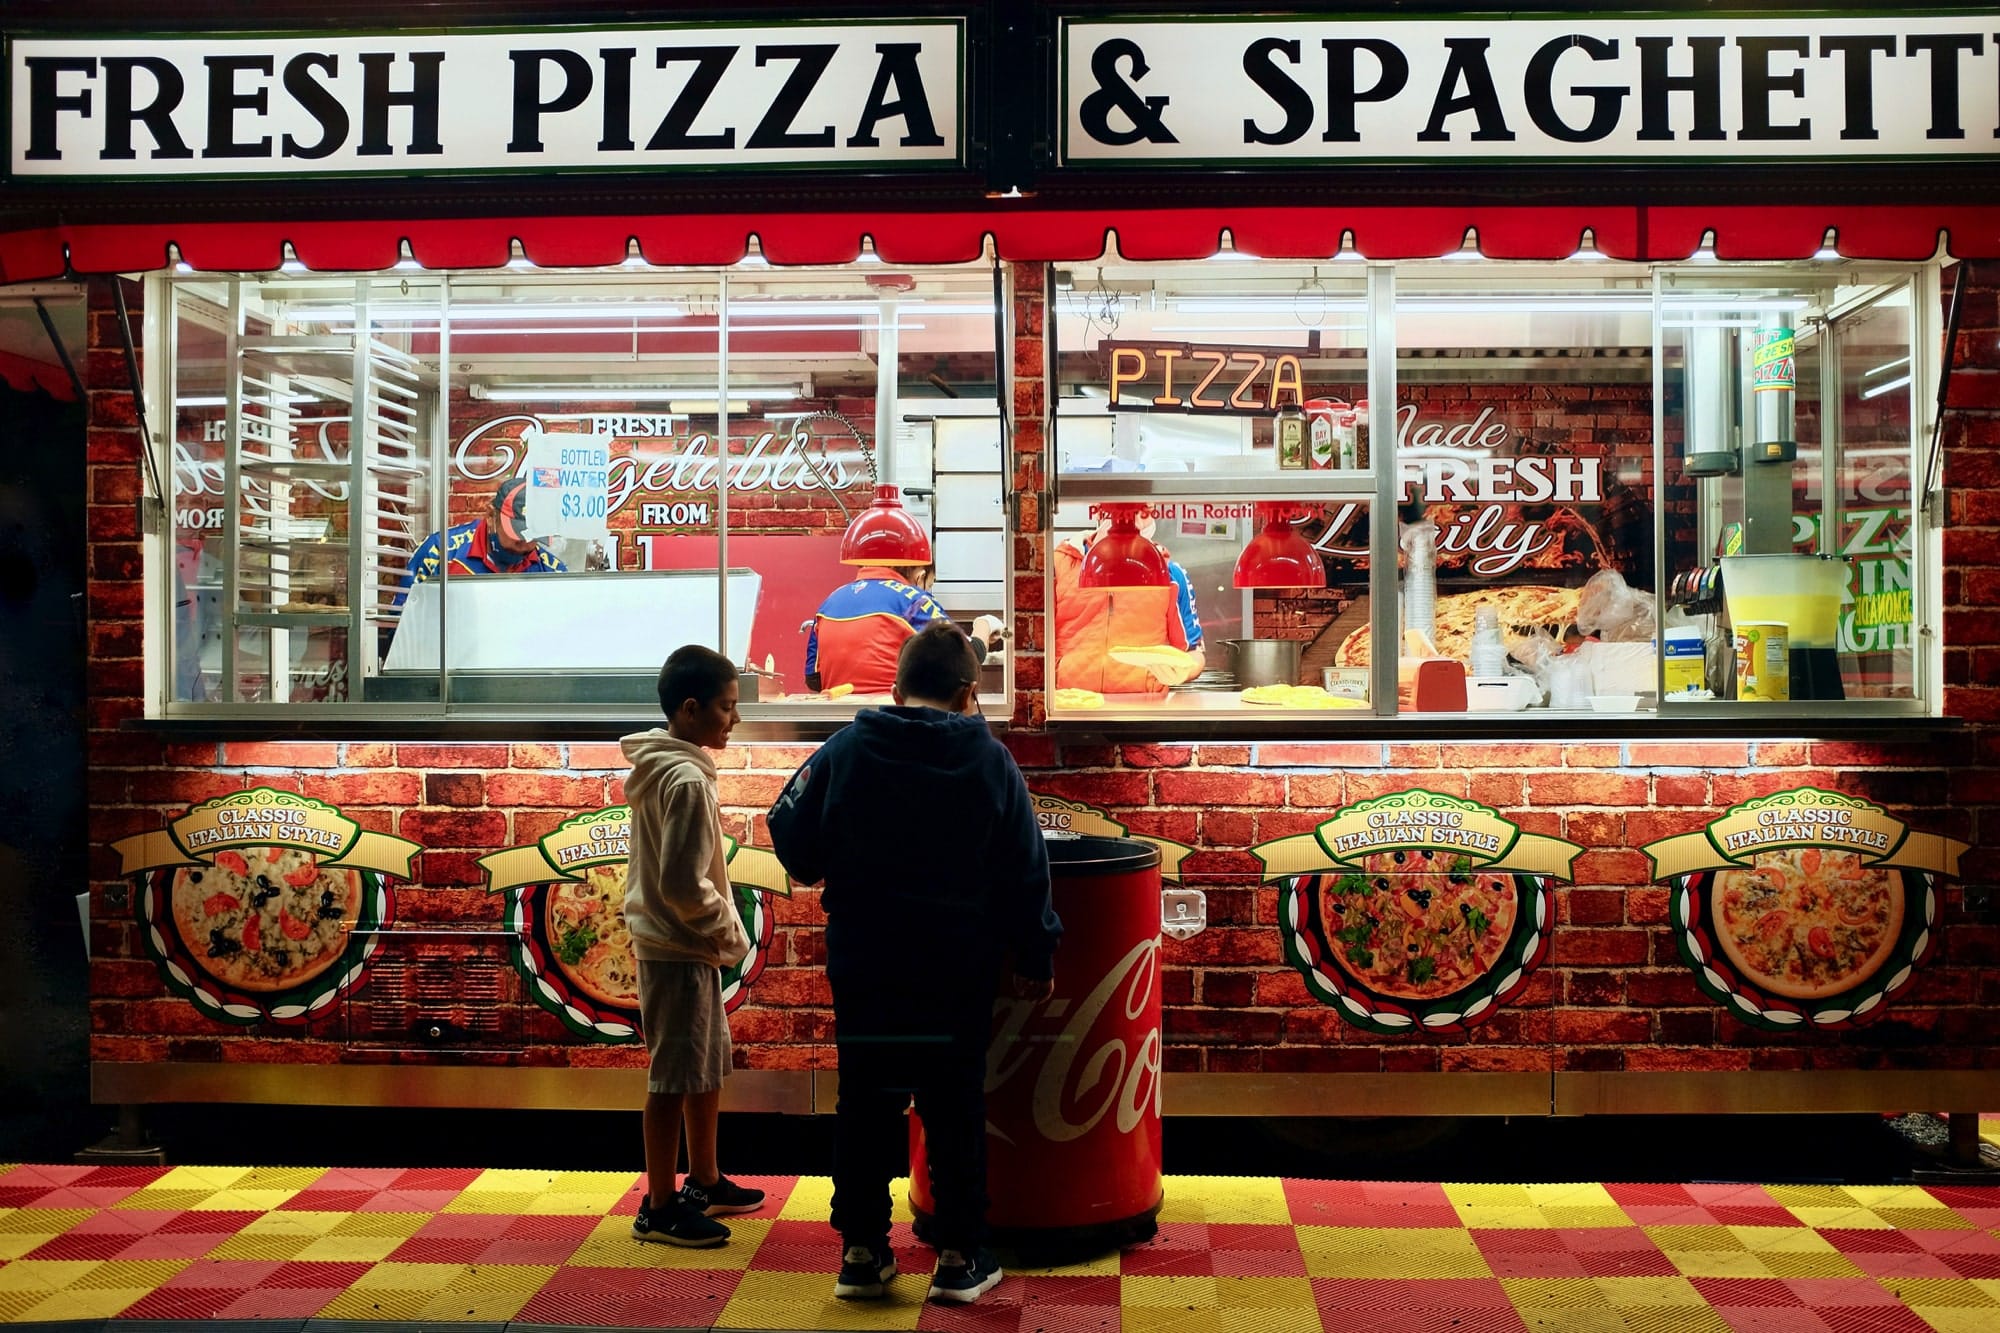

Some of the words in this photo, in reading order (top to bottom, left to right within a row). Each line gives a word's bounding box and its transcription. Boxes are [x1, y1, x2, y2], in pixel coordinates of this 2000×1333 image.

[1079, 37, 1180, 146] &
[1242, 33, 2000, 146] SPAGHETT
[25, 52, 446, 161] FRESH
[506, 42, 945, 154] PIZZA
[1111, 348, 1304, 409] PIZZA
[1754, 357, 1794, 380] PIZZA
[592, 417, 673, 437] FRESH
[561, 449, 606, 466] BOTTLED
[559, 470, 606, 488] WATER
[1397, 457, 1602, 501] FRESH
[562, 491, 605, 521] $3.00
[642, 503, 708, 525] FROM
[1140, 503, 1175, 519] Sold
[1182, 504, 1197, 518] In
[218, 808, 307, 827] CLASSIC
[1368, 810, 1463, 828] CLASSIC
[1757, 808, 1853, 826] CLASSIC
[187, 825, 272, 849] ITALIAN
[277, 825, 342, 849] STYLE
[1335, 827, 1426, 853] ITALIAN
[1431, 827, 1500, 852] STYLE
[1725, 825, 1815, 850] ITALIAN
[1821, 825, 1888, 849] STYLE
[558, 841, 630, 865] ITALIA
[682, 1184, 708, 1203] TICA
